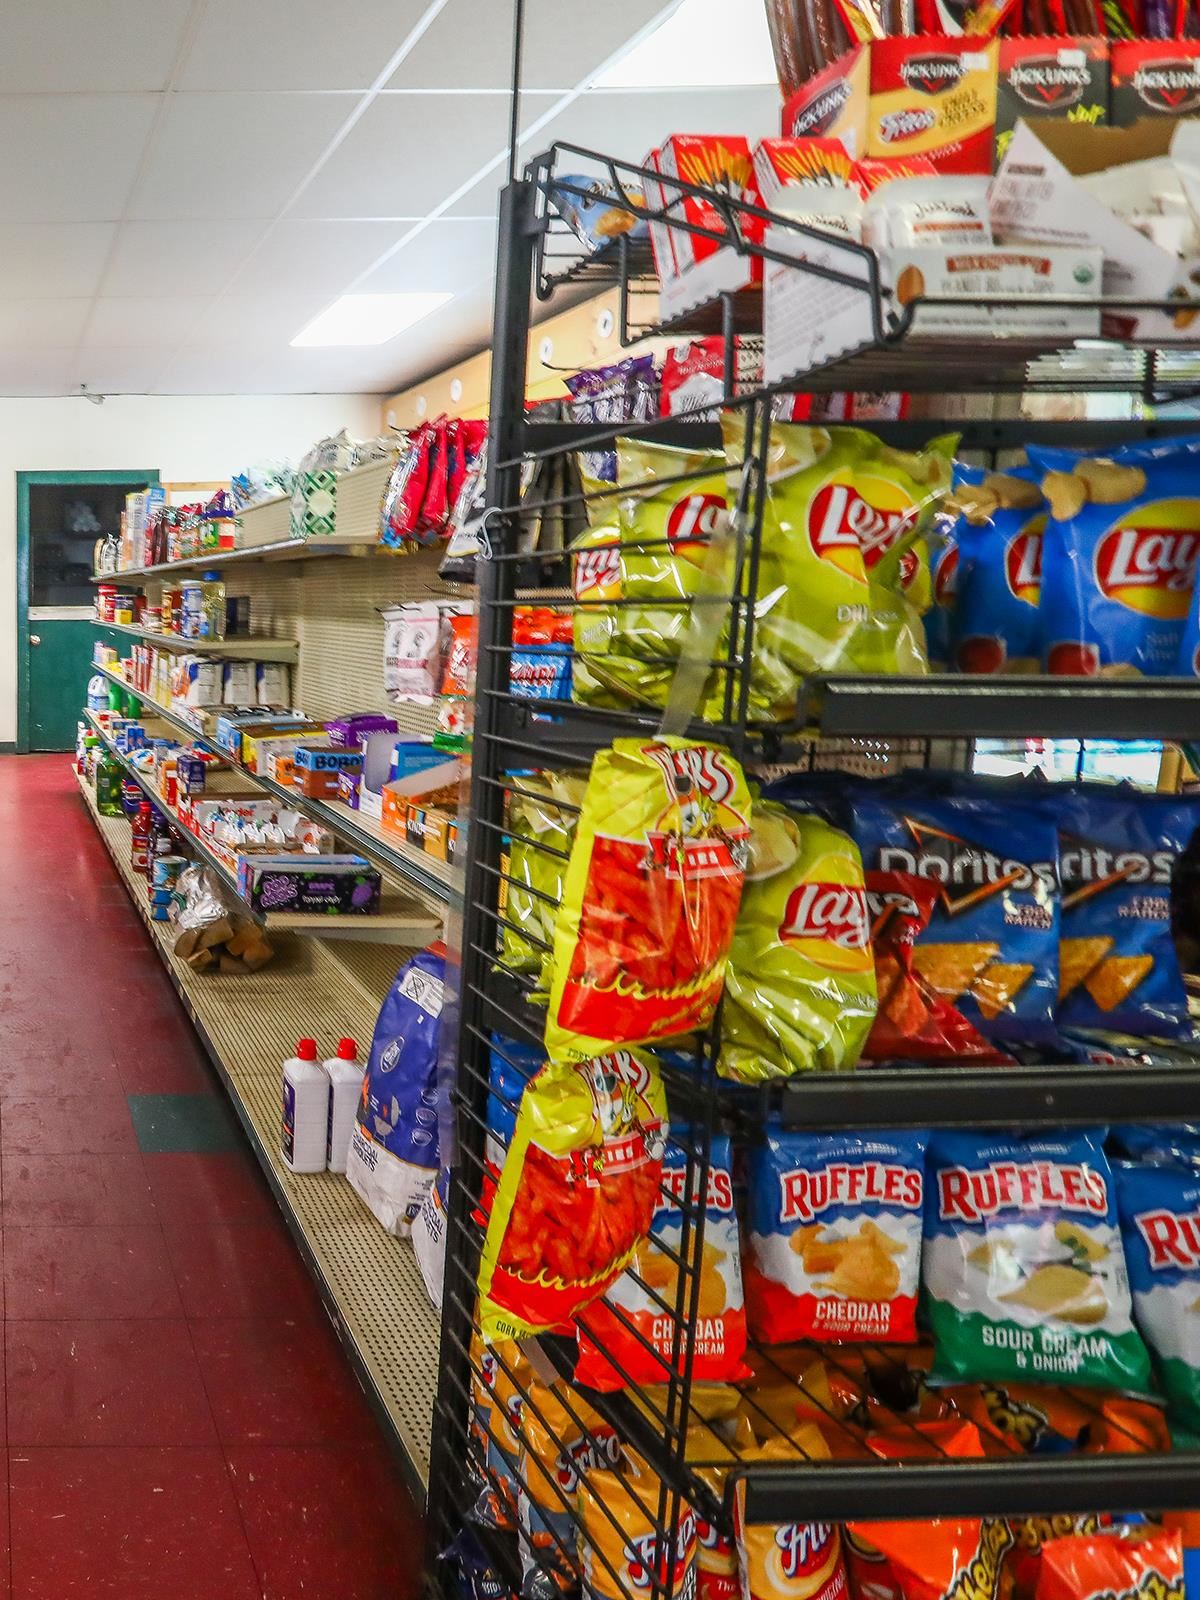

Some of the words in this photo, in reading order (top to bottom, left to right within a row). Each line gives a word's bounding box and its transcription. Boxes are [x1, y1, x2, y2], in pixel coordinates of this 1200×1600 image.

[838, 604, 868, 623] Dill
[880, 846, 1055, 889] Doritos
[1061, 847, 1175, 889] ritos
[783, 1164, 923, 1220] RUFFLES
[938, 1163, 1108, 1222] RUFFLES
[816, 1300, 891, 1323] CHEDDAR
[853, 1323, 890, 1336] CREAM
[983, 1325, 1035, 1353] SOUR
[1040, 1328, 1107, 1360] CREAM
[1017, 1353, 1027, 1368] &
[1031, 1355, 1079, 1374] ONION
